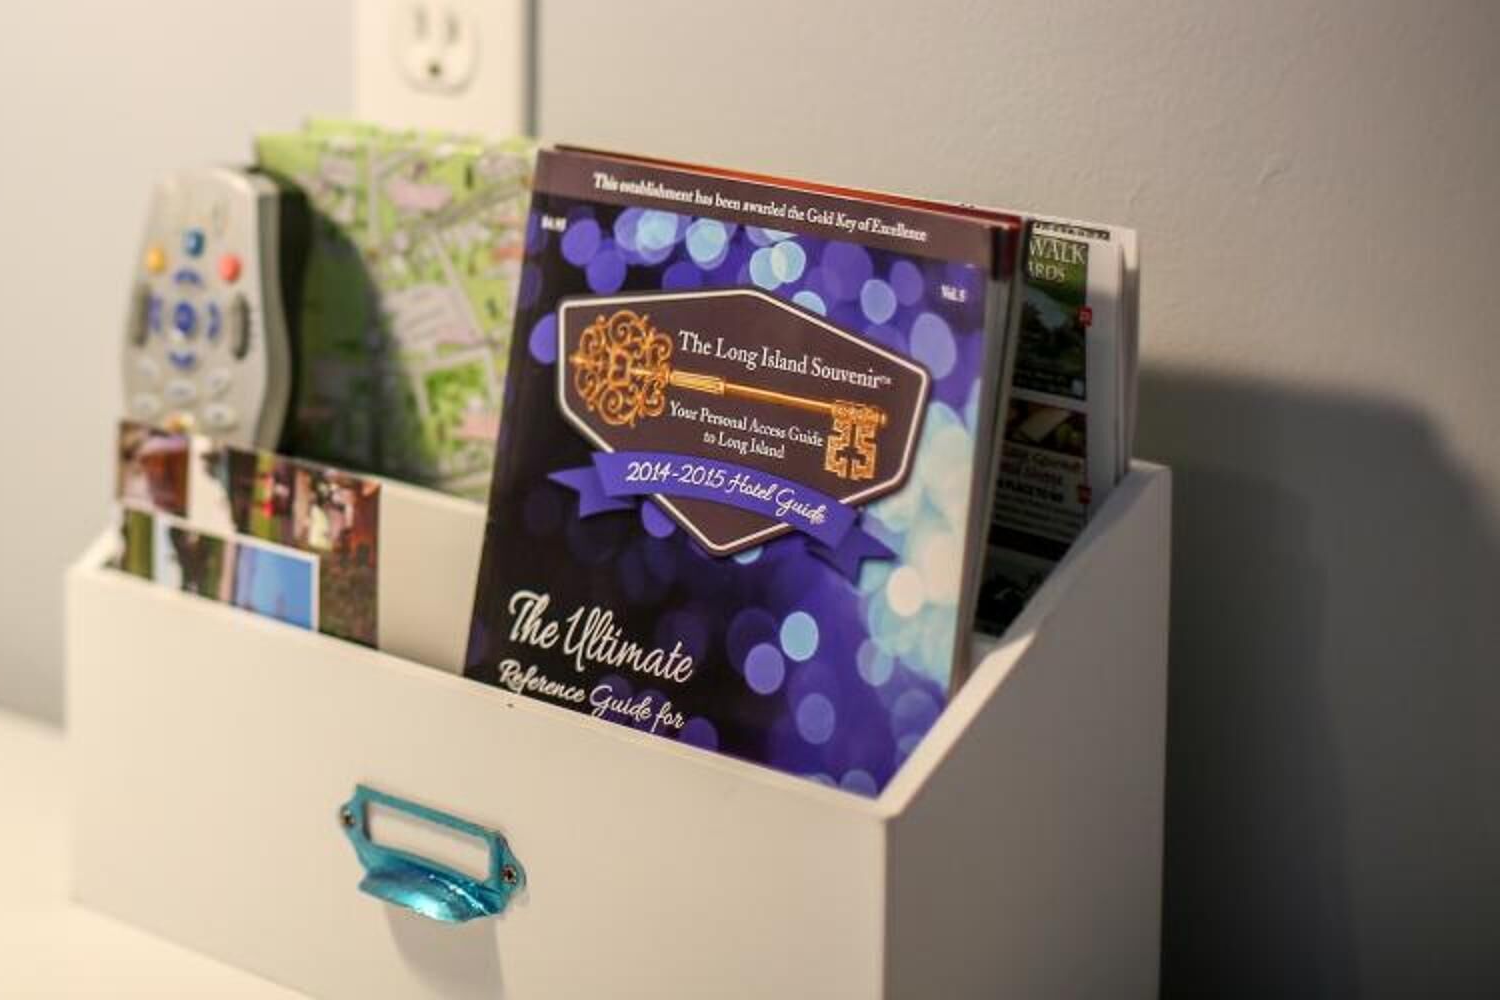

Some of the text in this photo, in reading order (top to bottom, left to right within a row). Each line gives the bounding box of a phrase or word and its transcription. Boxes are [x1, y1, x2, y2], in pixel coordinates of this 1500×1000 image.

[593, 171, 928, 242] This establishment has been awarded the Gold Key of Excellence
[1028, 237, 1086, 264] WALK
[678, 329, 712, 355] The
[715, 337, 759, 370] Long
[761, 346, 808, 375] Island
[670, 400, 825, 447] Your Personal Access Guide
[703, 431, 786, 459] to Long Island
[625, 461, 828, 525] 2014-2015 Hotel Guide
[508, 589, 695, 684] The Ultimate
[498, 658, 686, 733] Reference Guide for
